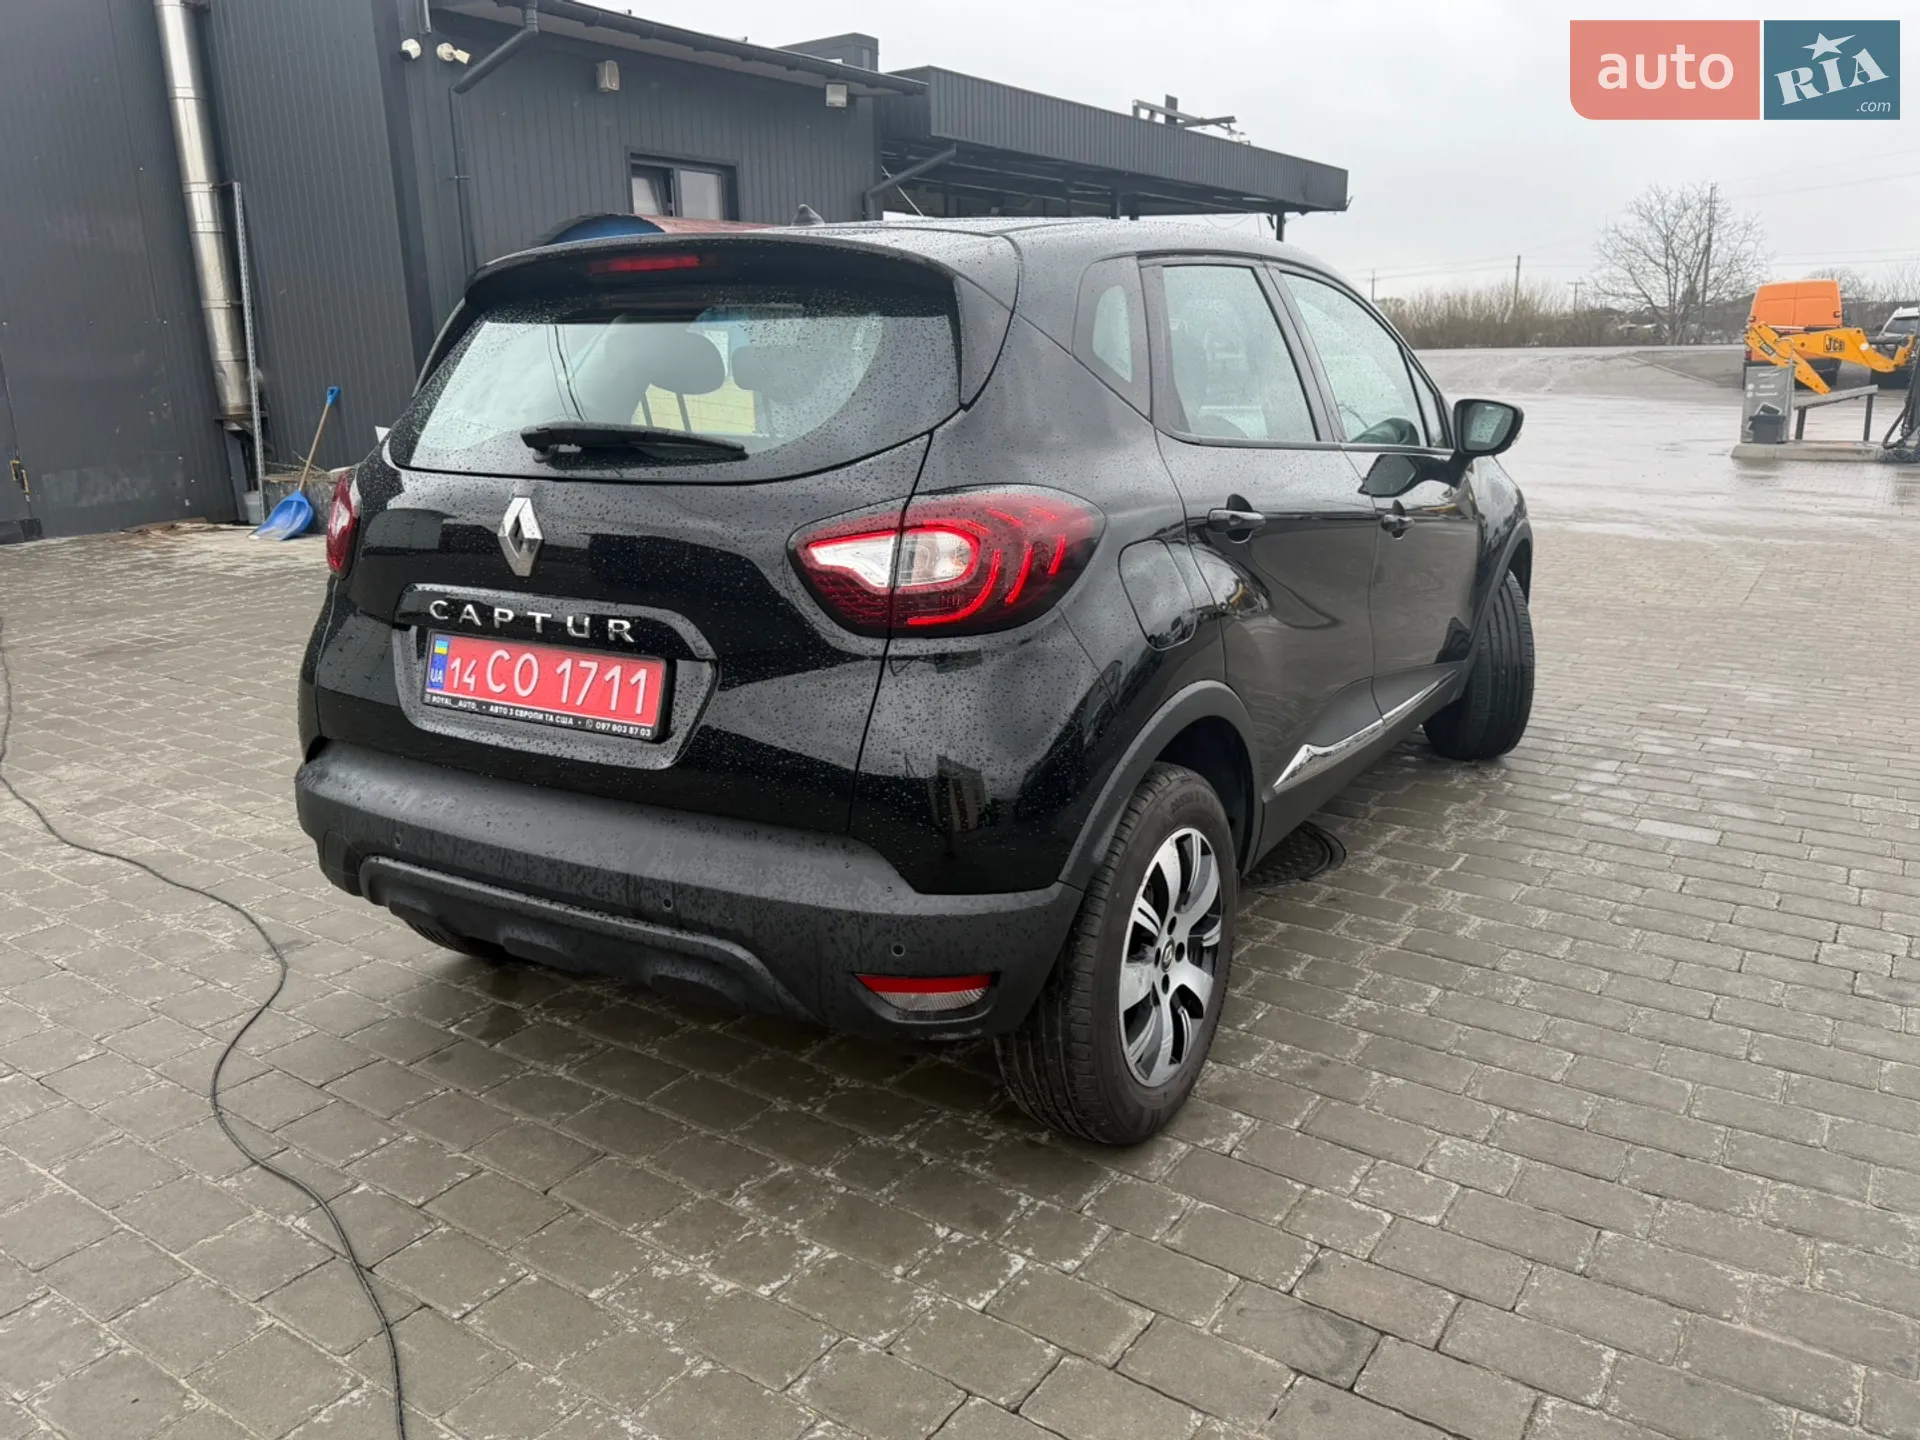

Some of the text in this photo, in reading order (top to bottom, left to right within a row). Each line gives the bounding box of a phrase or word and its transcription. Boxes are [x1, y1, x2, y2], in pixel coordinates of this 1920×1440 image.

[429, 600, 635, 643] CAPTUR
[430, 668, 444, 683] UA
[450, 649, 648, 716] 14 CO 1711
[489, 705, 508, 715] АВТО
[545, 713, 554, 723] ТА
[555, 715, 574, 726] США
[595, 721, 611, 731] 097
[640, 728, 651, 738] 03
